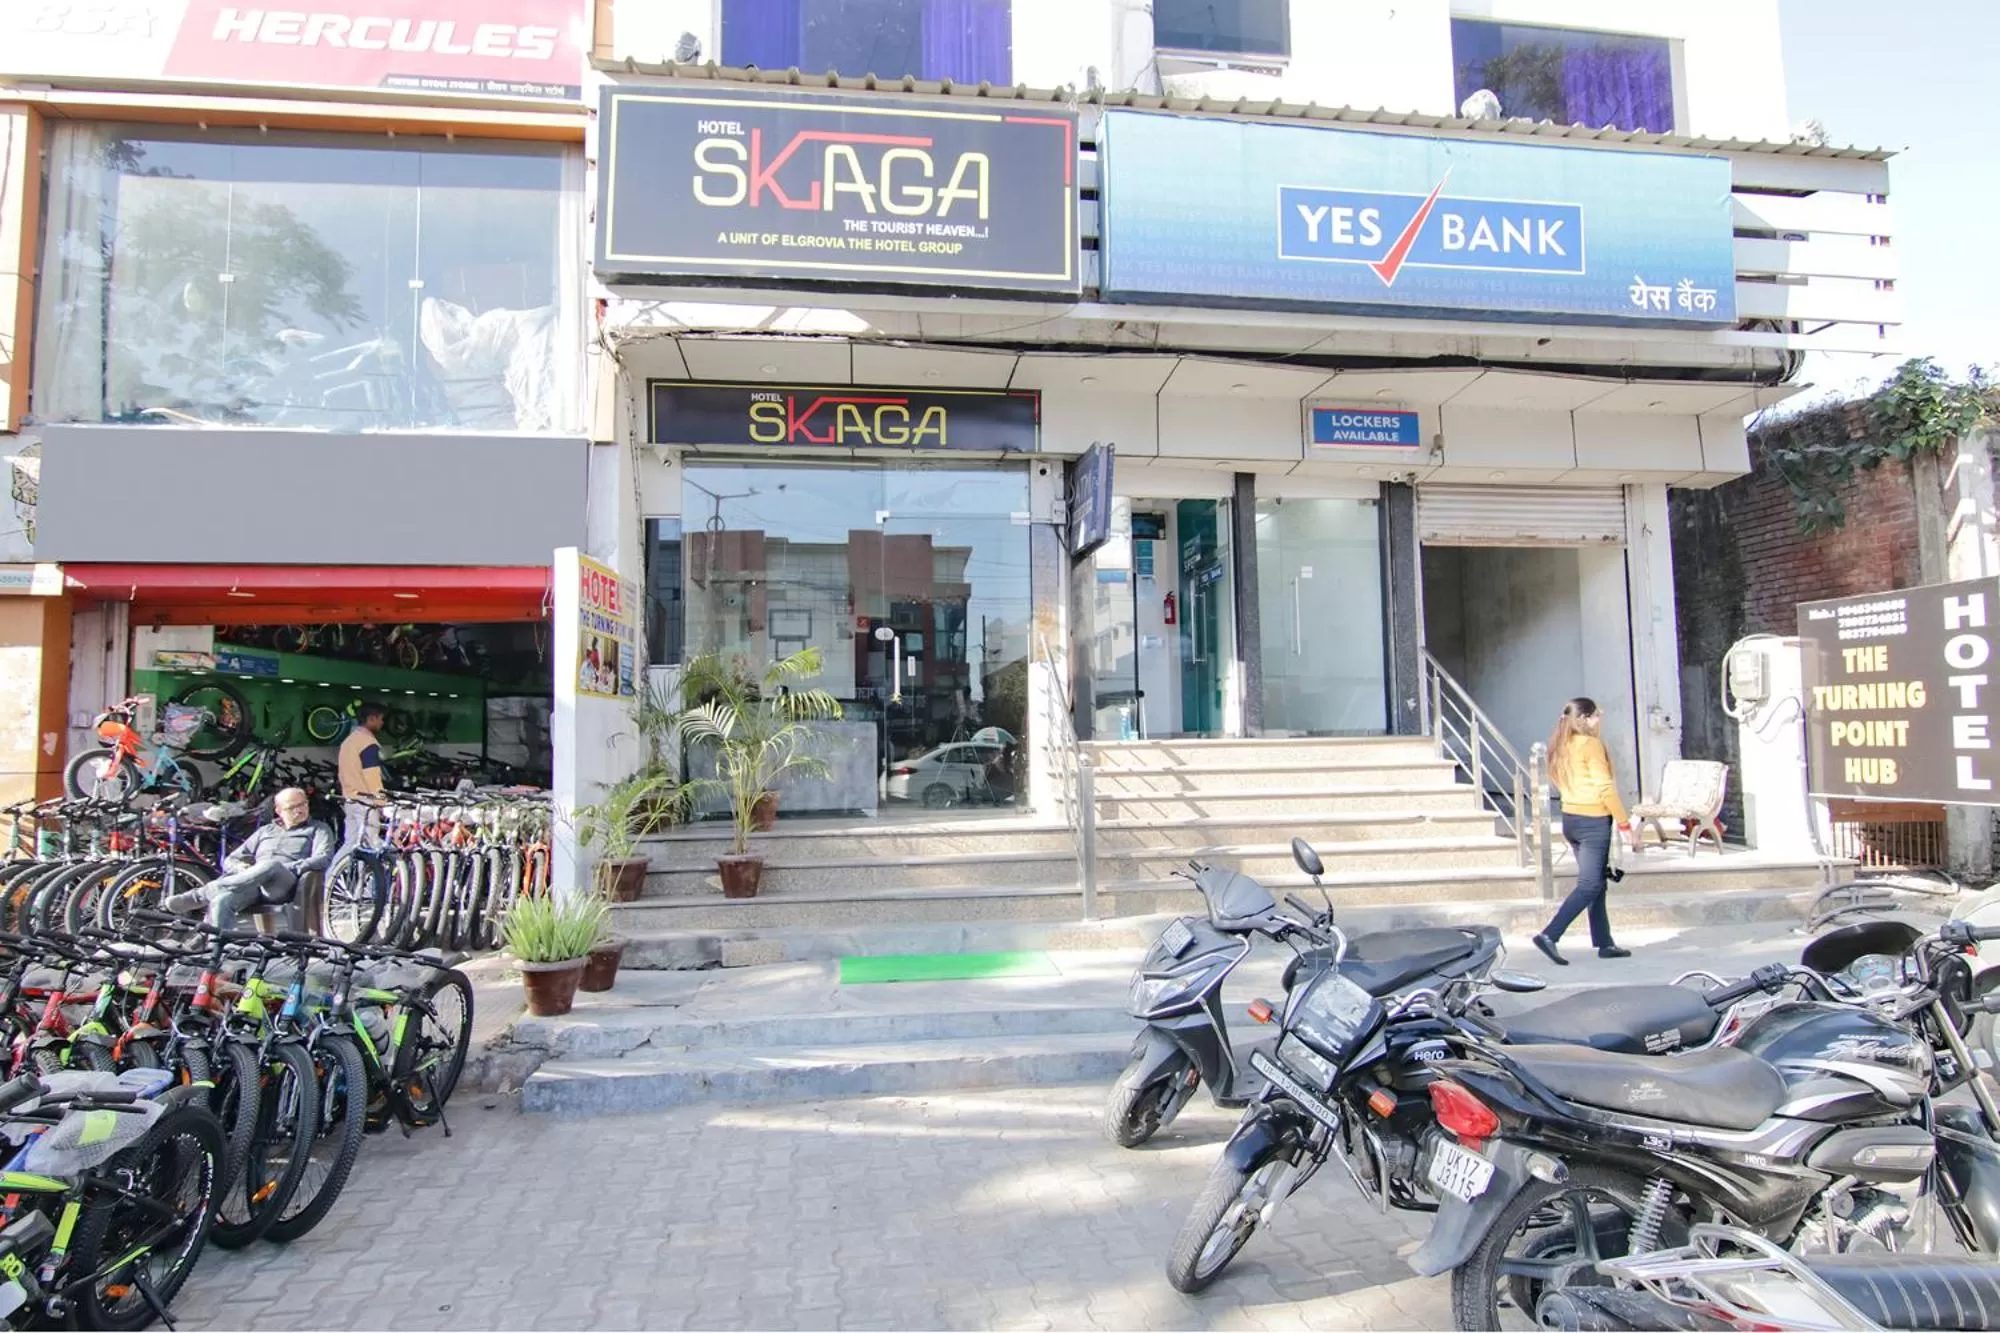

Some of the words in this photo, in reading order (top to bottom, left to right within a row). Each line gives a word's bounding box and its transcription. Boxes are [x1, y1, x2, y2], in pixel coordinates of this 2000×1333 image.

[212, 8, 561, 60] HERCULES
[698, 120, 744, 135] HOTEL
[693, 128, 989, 219] SKAGA
[843, 219, 867, 232] THE
[871, 220, 922, 235] TOURIST
[1297, 205, 1382, 247] YES
[1442, 213, 1567, 256] BANK
[718, 232, 728, 243] A
[730, 233, 757, 244] UNIT
[762, 234, 778, 245] OF
[782, 235, 845, 248] ELGROVIA
[848, 238, 872, 250] THE
[875, 240, 916, 252] HOTEL
[919, 241, 963, 254] GROUP
[1629, 275, 1672, 311] येस
[1676, 278, 1717, 313] बैंक
[751, 393, 783, 402] HOTEL
[750, 396, 946, 445] SKAGA
[1332, 415, 1400, 428] LOCKERS
[1333, 430, 1400, 442] AVAILABLE
[1842, 646, 1889, 673] THE
[1813, 681, 1926, 711] TURNING
[1943, 593, 1992, 790] HOTEL
[1831, 720, 1909, 747] POINT
[1845, 758, 1898, 784] HUB
[1414, 1050, 1445, 1061] Hero
[1437, 1165, 1475, 1199] J3115
